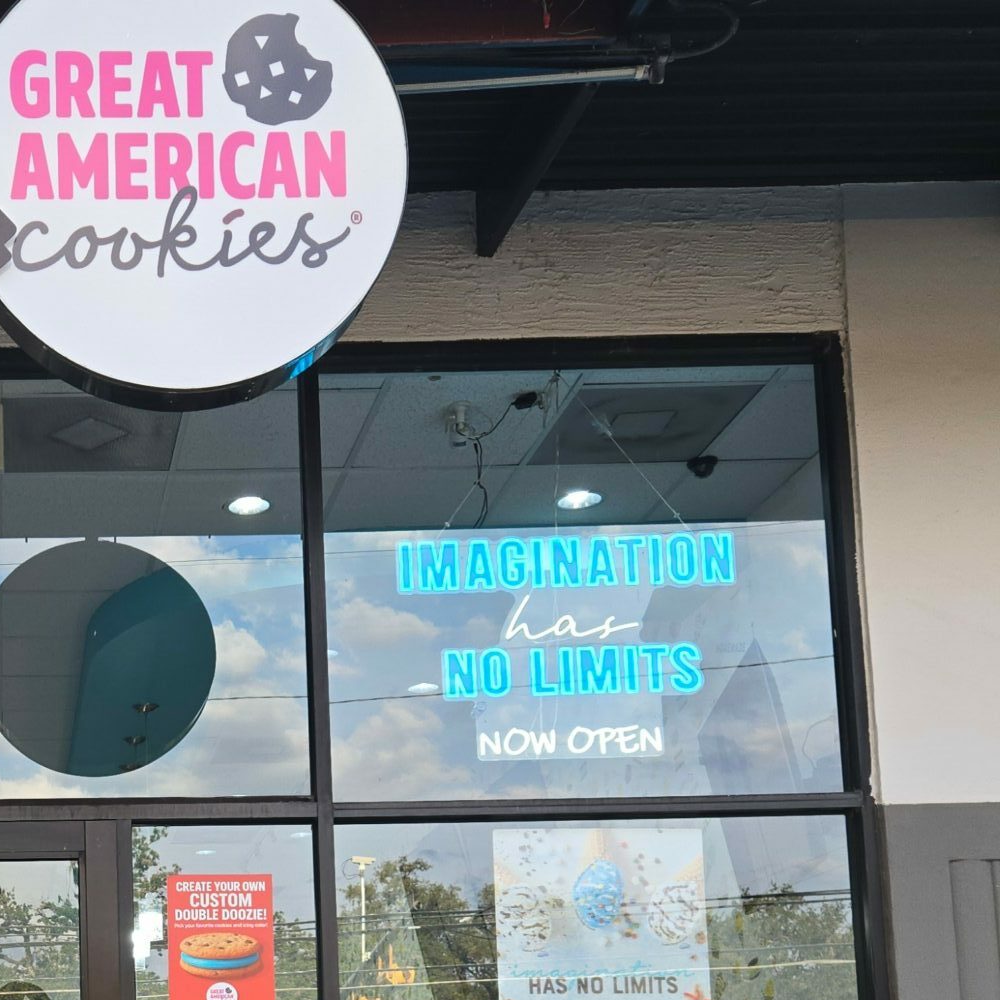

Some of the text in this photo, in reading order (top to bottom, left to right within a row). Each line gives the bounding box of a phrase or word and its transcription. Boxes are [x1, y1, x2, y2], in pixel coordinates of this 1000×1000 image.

[9, 50, 213, 119] GREAT
[10, 130, 347, 200] AMERICAN
[12, 185, 351, 278] cookies
[397, 532, 736, 594] IMAGINATION
[505, 595, 639, 640] has
[442, 643, 704, 699] NO LIMITS
[479, 724, 663, 757] NOW OPEN
[175, 881, 266, 892] CREATE YOUR OWN
[190, 893, 252, 907] CUSTOM
[174, 908, 267, 921] DOUBLE DOOZIE!
[529, 976, 679, 995] HAS NO LIMITS
